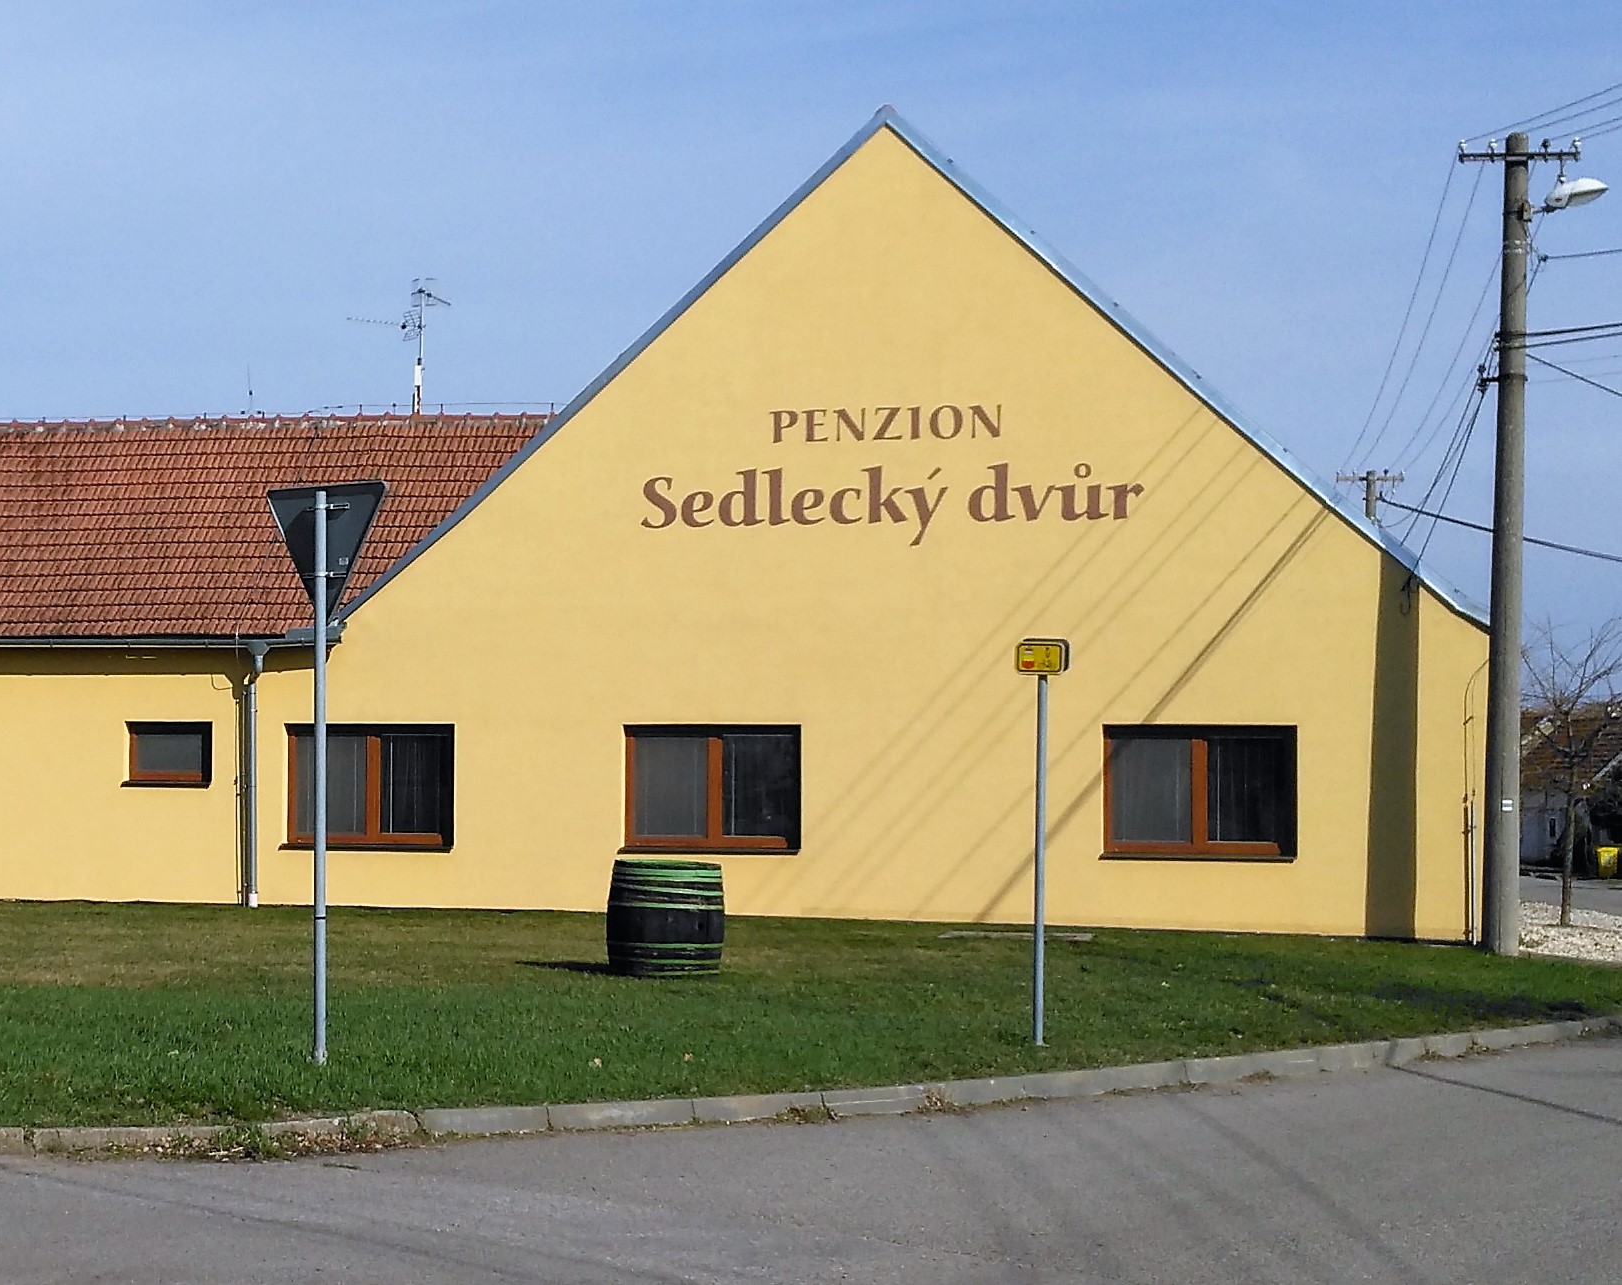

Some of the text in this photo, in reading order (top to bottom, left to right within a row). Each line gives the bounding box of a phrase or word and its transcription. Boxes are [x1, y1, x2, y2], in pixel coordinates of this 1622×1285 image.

[769, 403, 1003, 443] PENZION
[641, 461, 1145, 548] Sedlecký dvůr
